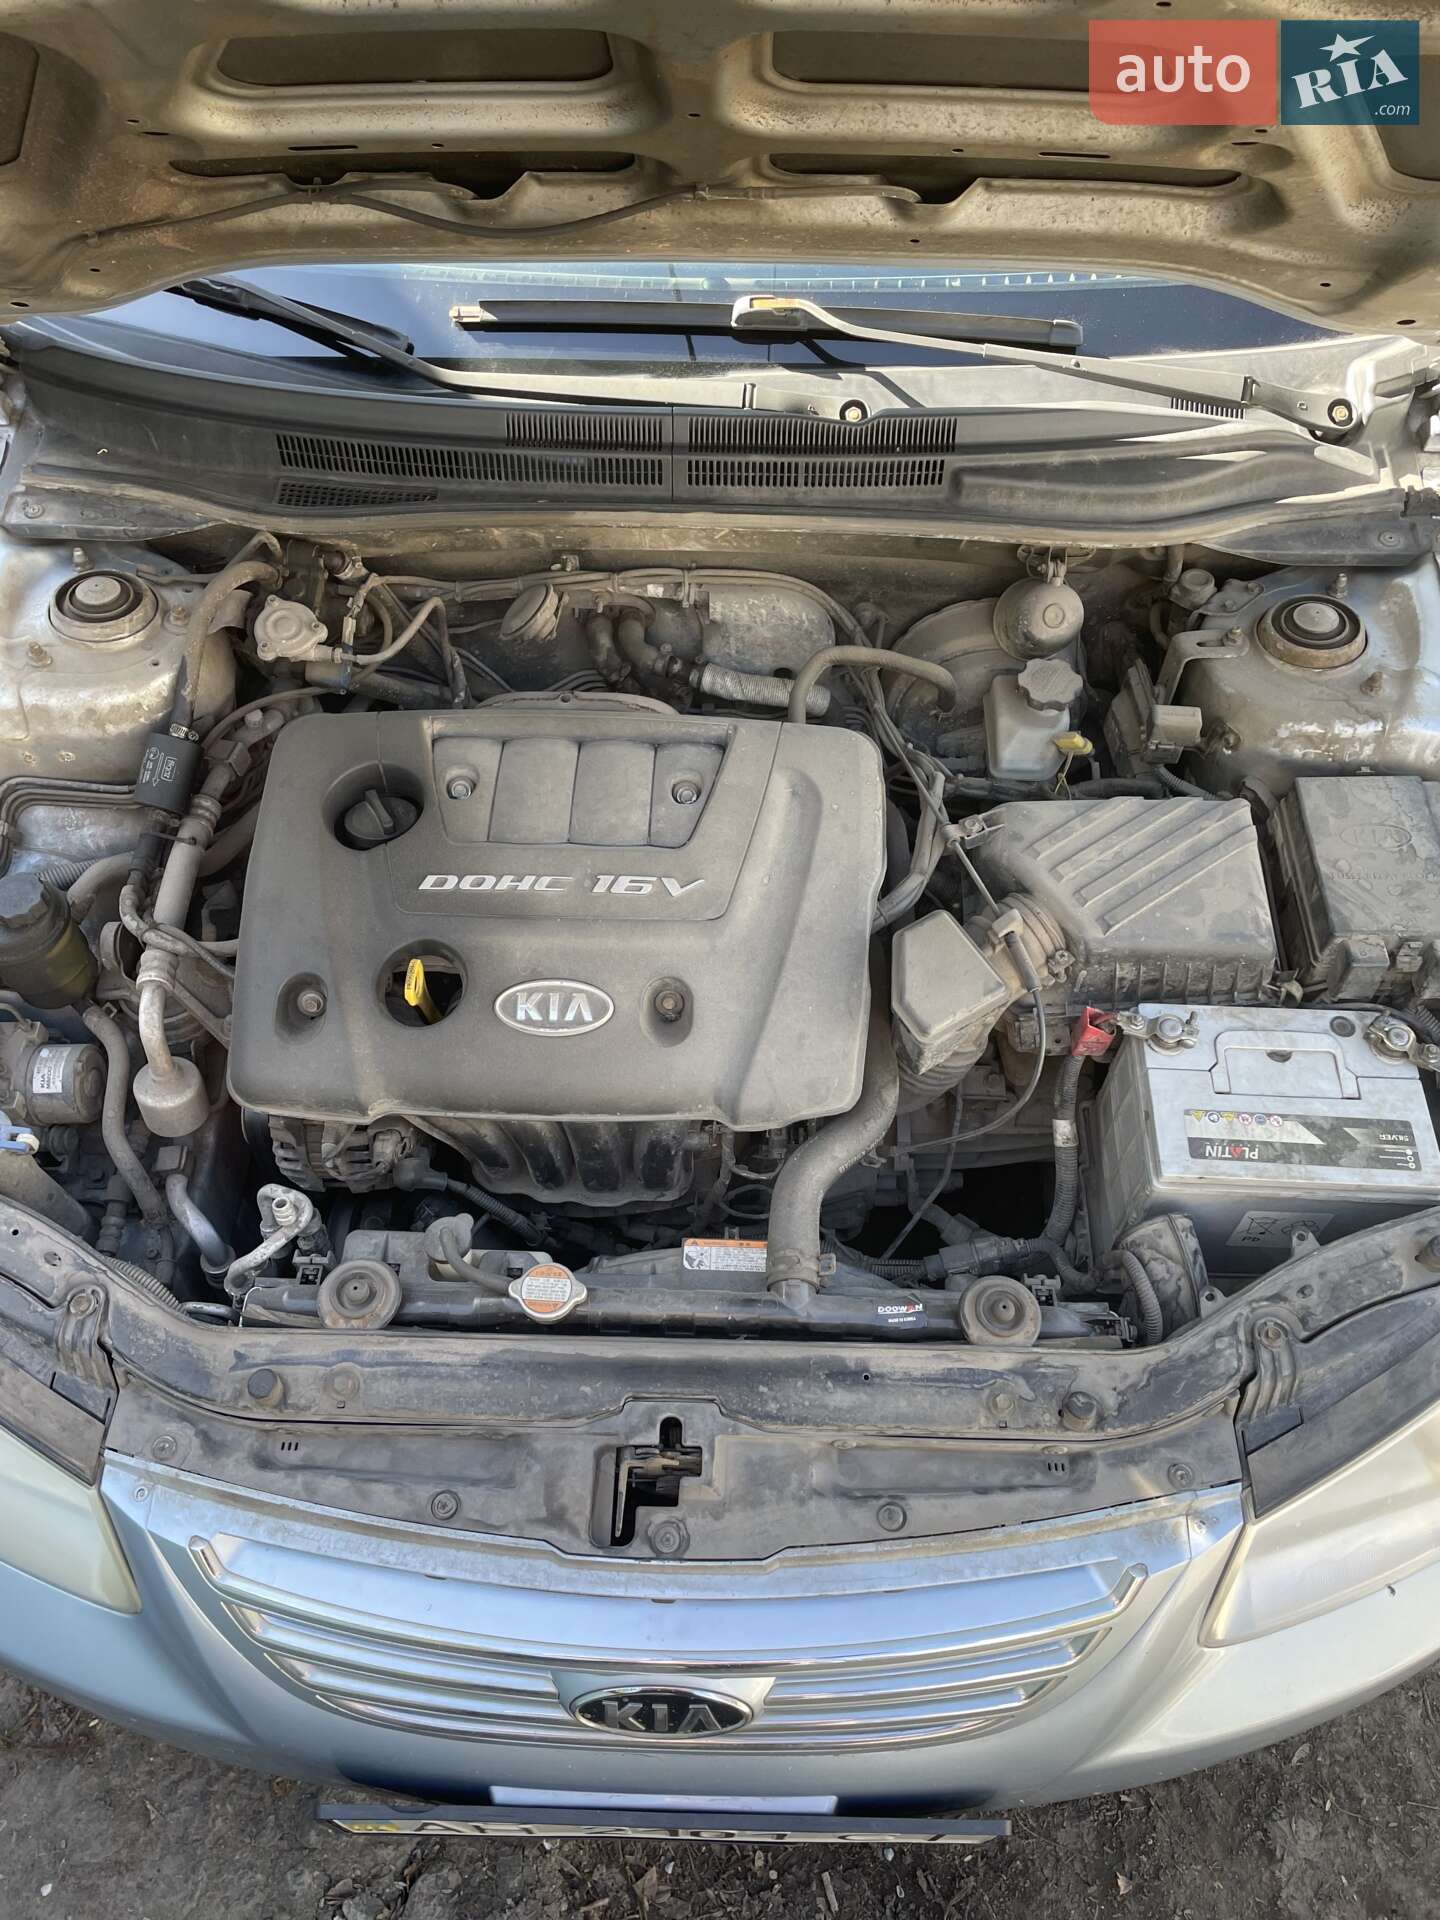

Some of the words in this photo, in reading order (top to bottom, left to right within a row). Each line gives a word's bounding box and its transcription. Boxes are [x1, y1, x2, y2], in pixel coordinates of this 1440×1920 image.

[418, 874, 574, 892] DOHC
[592, 874, 705, 898] 16V
[515, 991, 594, 1022] KIA
[1204, 1144, 1260, 1160] PLATIN
[877, 1303, 924, 1314] DOOWAN
[601, 1700, 723, 1735] KIA
